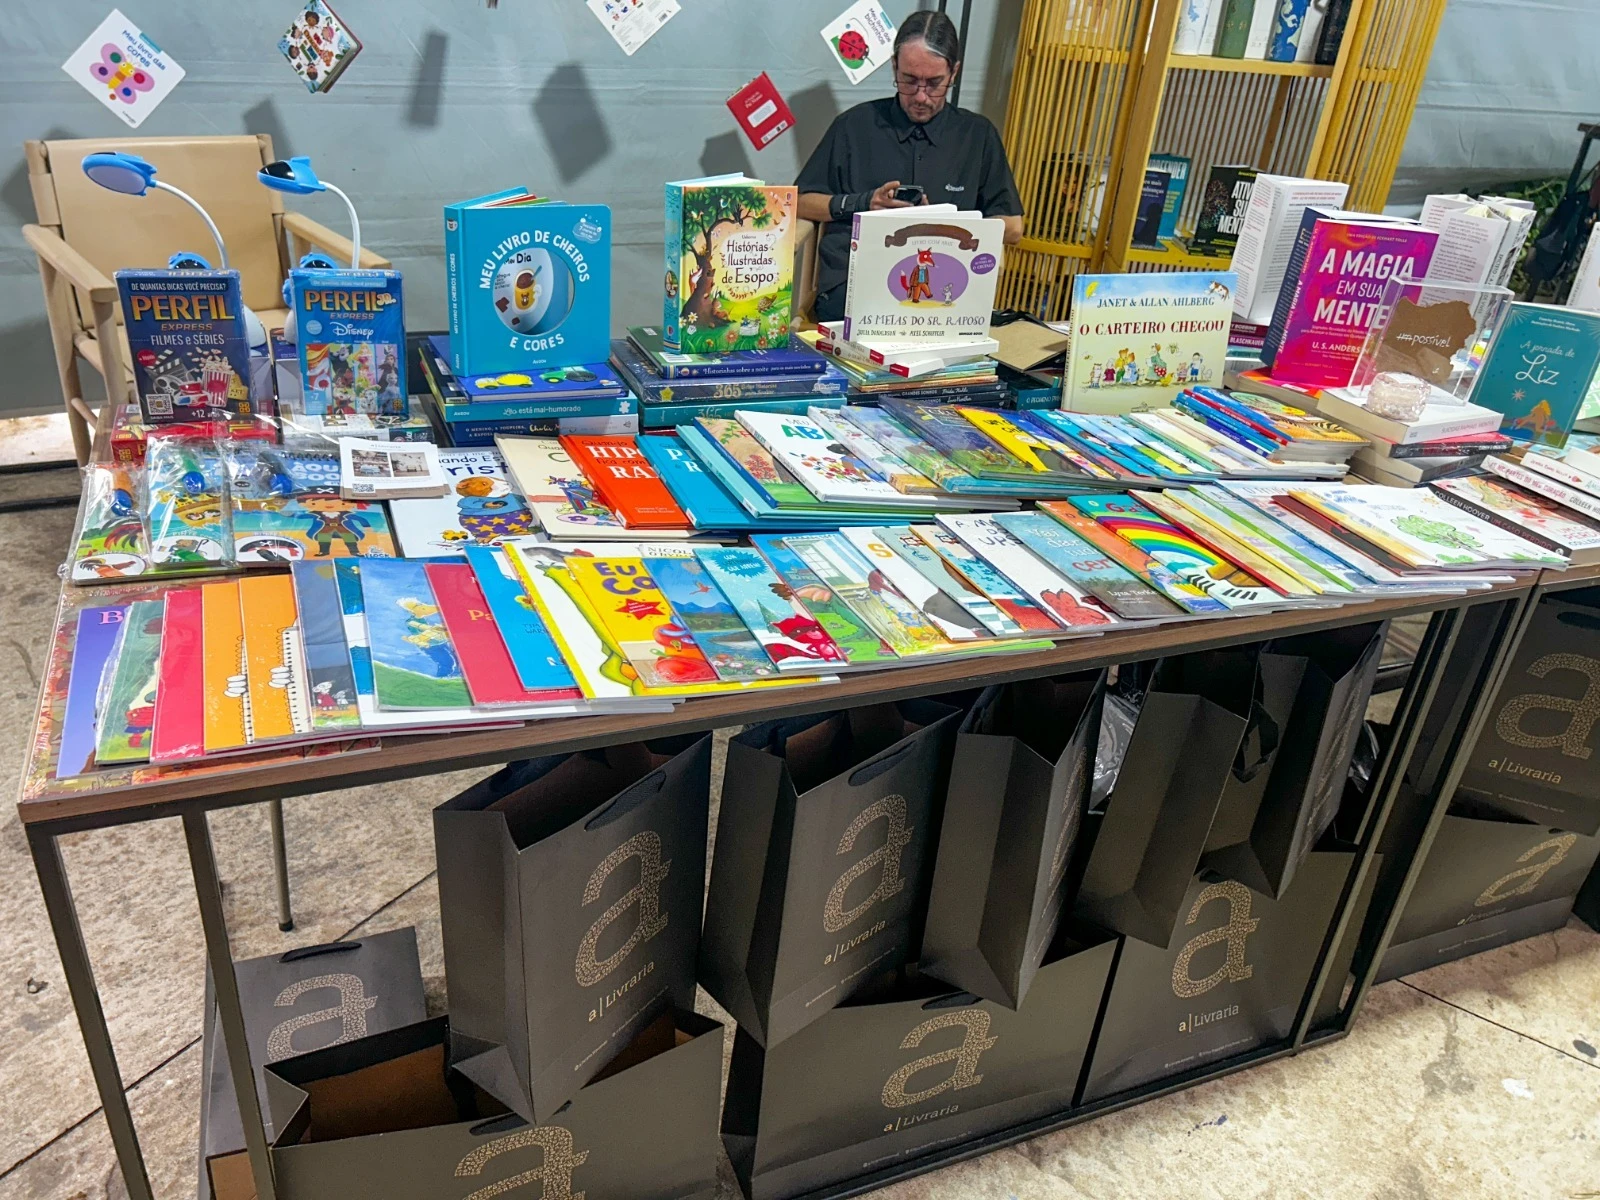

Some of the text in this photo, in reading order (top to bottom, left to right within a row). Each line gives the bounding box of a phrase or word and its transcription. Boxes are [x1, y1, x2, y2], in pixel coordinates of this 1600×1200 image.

[864, 14, 886, 45] bichinhos
[122, 30, 166, 70] Meu livro das
[127, 45, 151, 68] cores
[1232, 181, 1253, 200] ATIV
[1233, 201, 1248, 217] SU
[1217, 215, 1244, 234] MENT
[727, 240, 769, 252] Histórias
[479, 259, 496, 289] MEU
[494, 232, 531, 259] LIVRO
[534, 230, 551, 244] DE
[552, 234, 590, 282] CHEIROS
[516, 254, 532, 264] Dia
[727, 254, 773, 266] Ilustradas
[1319, 248, 1415, 280] A MAGIA
[184, 282, 200, 290] VOCÊ
[200, 282, 226, 290] PRECISA?
[722, 268, 774, 289] de Esopo
[1336, 280, 1383, 300] EM SUA
[130, 295, 236, 320] PERFIL
[304, 290, 384, 312] PERFIL
[1097, 298, 1128, 308] JANET
[1138, 298, 1168, 307] ALLAN
[1172, 296, 1215, 306] AHLBERG
[859, 314, 872, 326] AS
[876, 314, 908, 326] MEIAS
[911, 315, 924, 326] DO
[946, 316, 985, 326] RAPOSO
[1313, 298, 1391, 329] MENTE
[161, 323, 213, 332] EXPRESS
[1080, 320, 1224, 336] O CARTEIRO CHEGOU
[151, 332, 225, 346] FILMES e SÉRIES
[510, 333, 564, 351] E CORES
[1321, 342, 1328, 350] S.
[1515, 354, 1560, 386] Liz
[714, 384, 742, 398] 365
[518, 406, 532, 414] está
[534, 406, 582, 414] mal-humorado
[1434, 490, 1463, 508] COLLEEN
[1462, 502, 1490, 521] HOOVER
[823, 794, 915, 934] a
[575, 830, 672, 988] a
[1172, 880, 1260, 998] a
[882, 1008, 999, 1110] a
